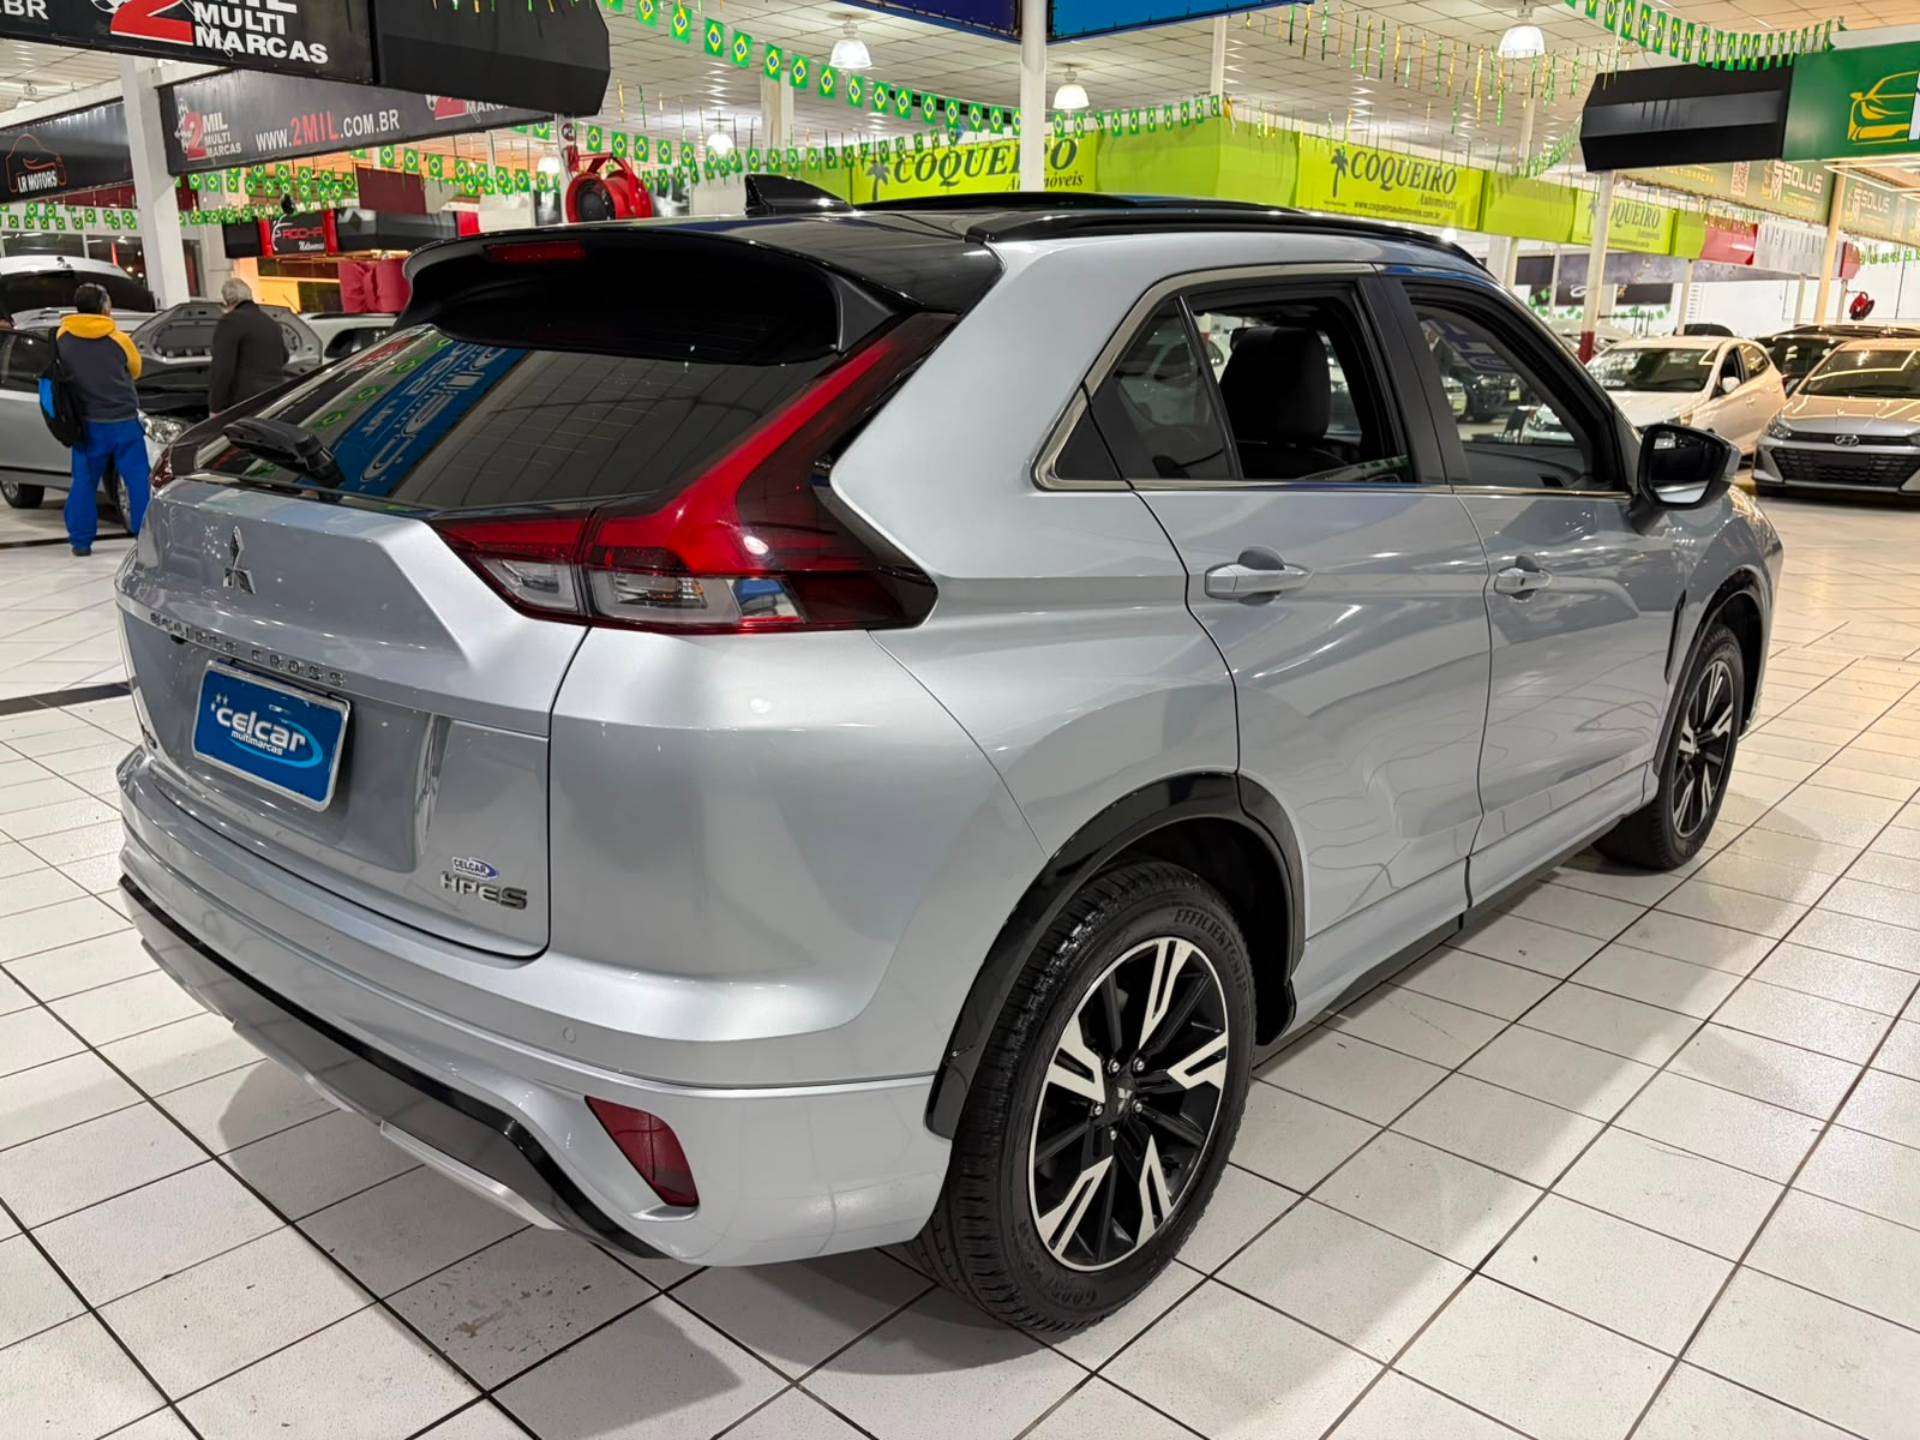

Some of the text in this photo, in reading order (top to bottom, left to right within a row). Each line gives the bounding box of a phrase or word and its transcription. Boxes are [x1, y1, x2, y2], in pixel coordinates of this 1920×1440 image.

[193, 2, 286, 35] MULTI
[195, 25, 329, 65] MARCAS
[202, 112, 228, 132] MIL
[255, 109, 400, 152] WWW.2MIL.COM.BR
[204, 132, 231, 145] MULTI
[205, 142, 242, 157] MARCAS
[894, 138, 1078, 187] COQUEIO
[1351, 151, 1458, 194] COQUEIRO
[27, 169, 58, 192] MOTORS
[1783, 164, 1824, 194] SOLUS
[1610, 200, 1661, 229] QUEIRO
[216, 707, 306, 751] celcar
[231, 730, 283, 757] multimarcas
[453, 858, 487, 874] CELCAR
